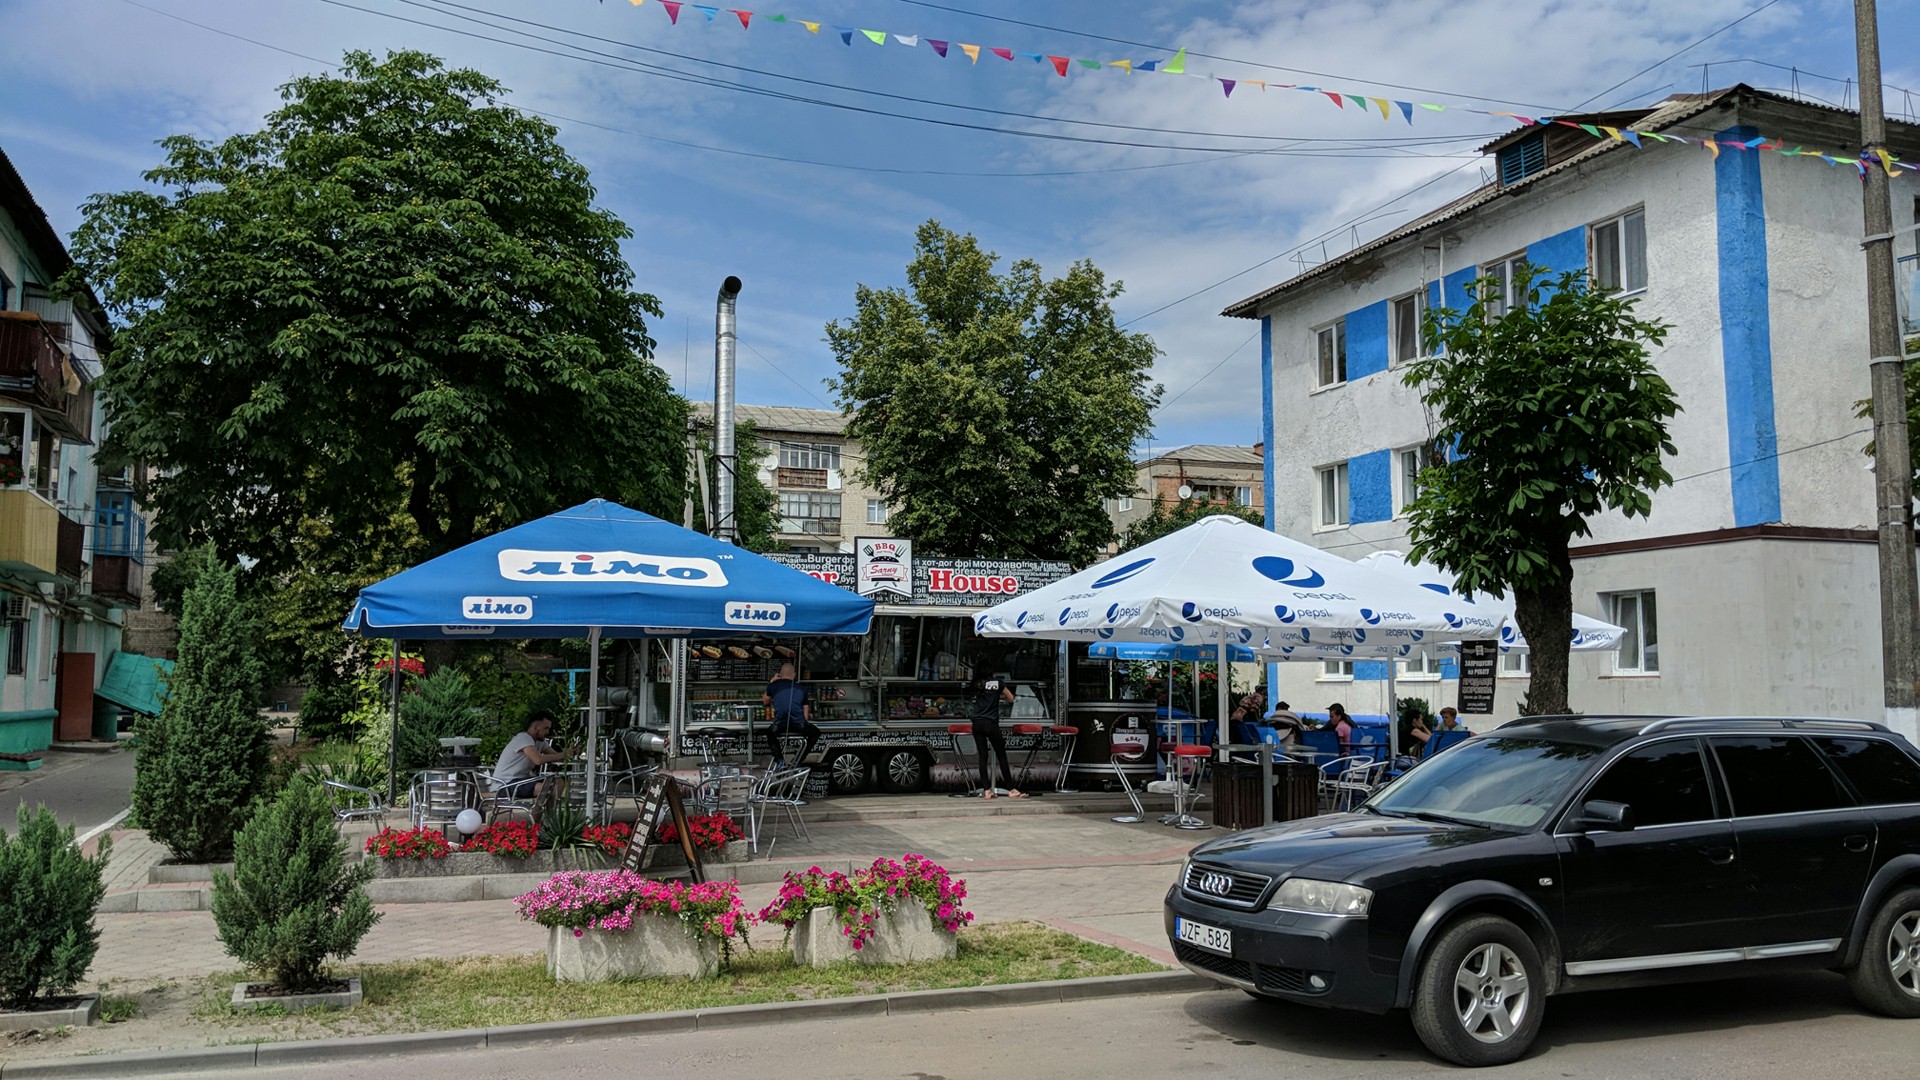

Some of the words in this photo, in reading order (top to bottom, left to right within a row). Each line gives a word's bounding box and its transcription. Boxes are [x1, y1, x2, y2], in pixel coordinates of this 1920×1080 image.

[875, 543, 896, 551] BBQ
[807, 553, 842, 565] Burger
[922, 560, 953, 568] хот-дог
[954, 559, 972, 569] фрі
[973, 560, 1022, 569] морозиво
[870, 564, 897, 575] Sarny
[930, 569, 1017, 592] House
[468, 598, 528, 615] лімо
[729, 604, 782, 621] лімо
[1119, 605, 1141, 619] pepsi
[1297, 607, 1330, 618] pepsi
[1027, 612, 1045, 624] pepsi
[1070, 608, 1090, 622] pepsi
[1382, 612, 1414, 622] pepsi
[1465, 616, 1492, 628] pepsi
[1585, 632, 1611, 642] pepsi
[1181, 921, 1201, 941] JZF
[1208, 928, 1230, 950] 582
